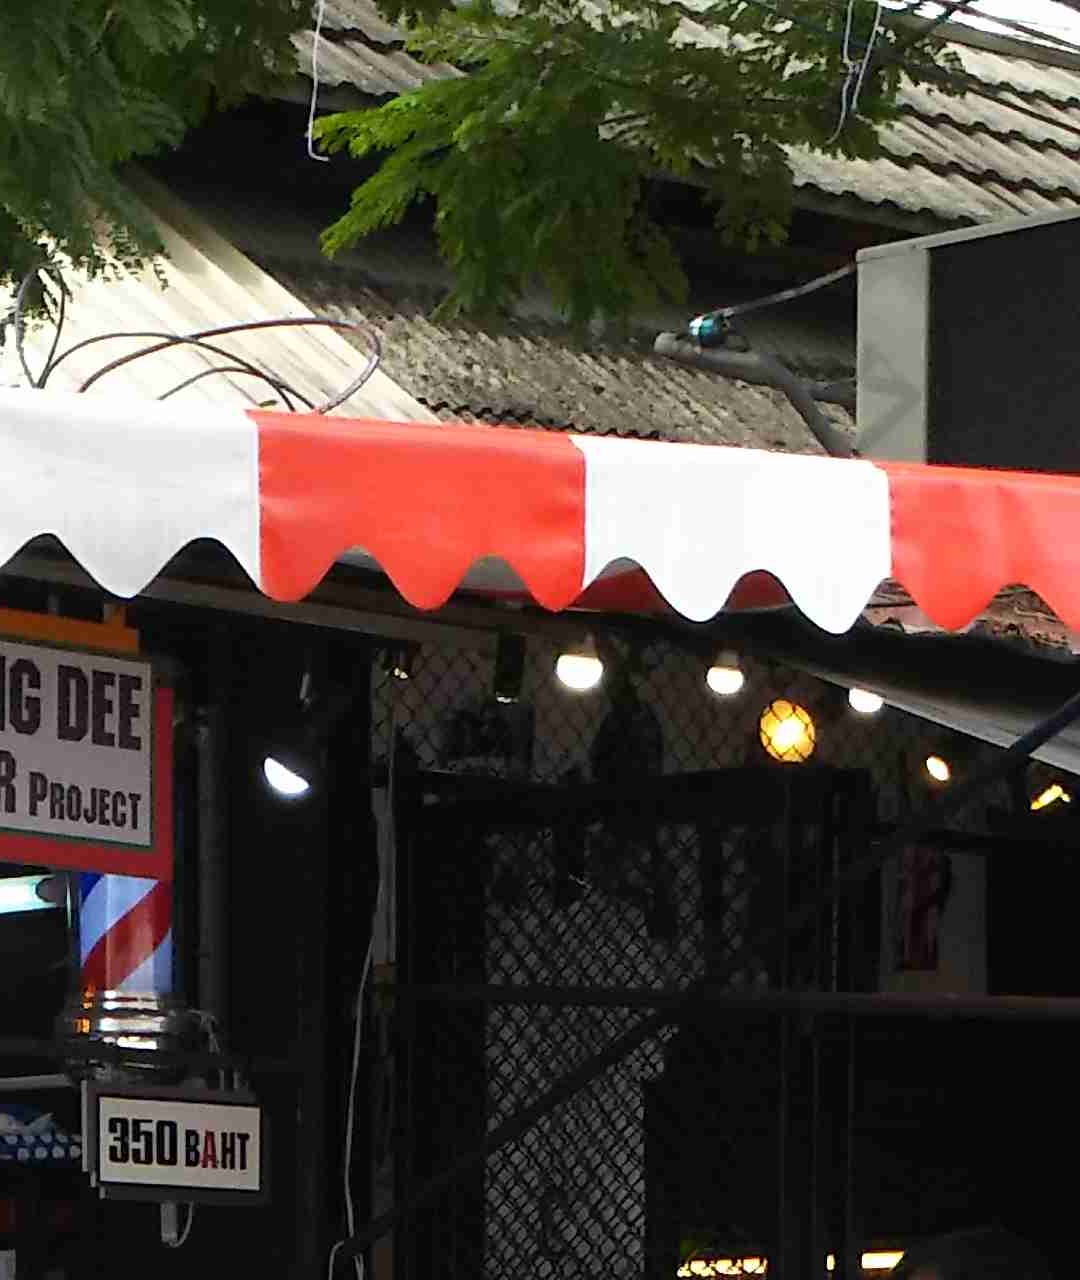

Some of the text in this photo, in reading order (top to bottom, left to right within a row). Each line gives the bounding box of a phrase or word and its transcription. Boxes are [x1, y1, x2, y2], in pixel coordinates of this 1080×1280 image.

[56, 664, 143, 752] DEE
[29, 770, 142, 831] PROJECT
[108, 1117, 250, 1171] 350 BAHT
